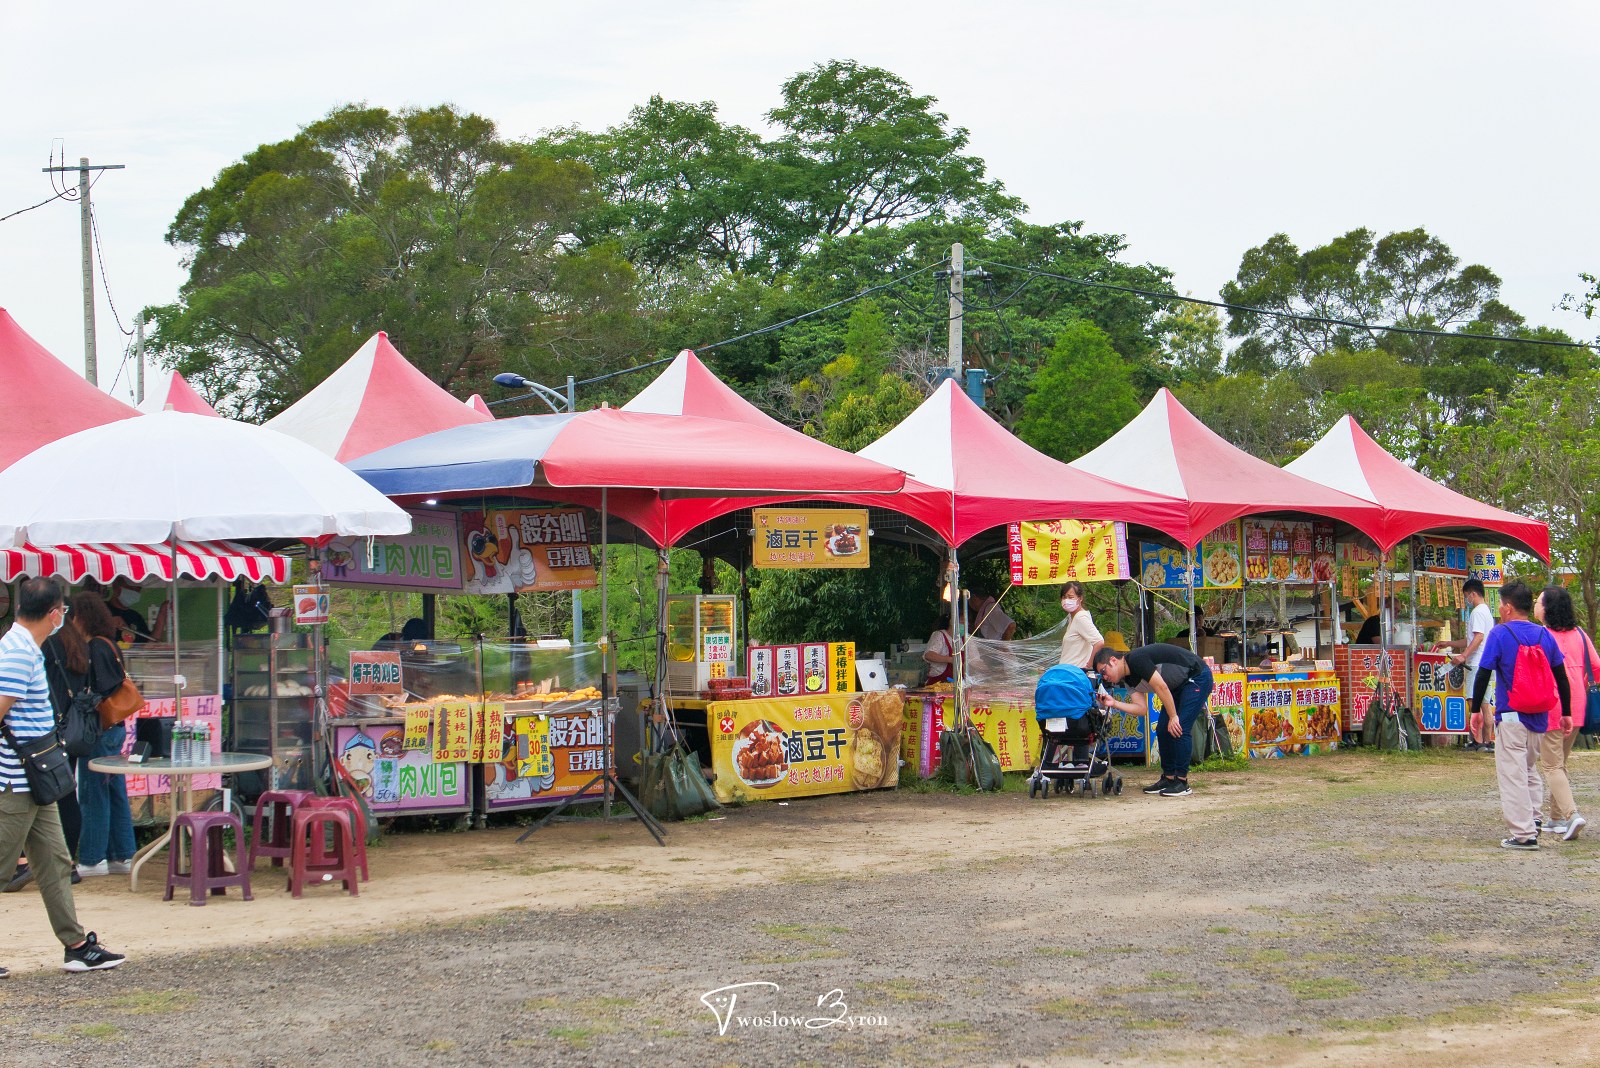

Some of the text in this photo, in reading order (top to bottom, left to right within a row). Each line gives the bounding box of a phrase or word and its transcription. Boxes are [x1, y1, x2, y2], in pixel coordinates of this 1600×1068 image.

[766, 529, 818, 549] 滷豆干
[384, 543, 454, 579] 肉刈包
[1424, 543, 1468, 571] 黑糖粉圓
[1473, 553, 1496, 566] 盆栽
[835, 644, 848, 693] 香椿拌麵
[1250, 690, 1292, 707] 無骨排骨酥
[1296, 687, 1338, 705] 無骨香酥雞
[414, 709, 429, 718] 100
[849, 704, 861, 724] 素
[1422, 697, 1466, 730] 粉圓
[414, 724, 428, 734] 150
[454, 708, 468, 745] 花枝丸
[489, 709, 502, 744] 熱狗
[453, 748, 467, 759] 30
[530, 740, 540, 755] 30
[781, 728, 847, 765] 滷豆干
[997, 720, 1012, 767] 金針菇
[436, 749, 450, 760] 30
[472, 749, 485, 760] 50
[488, 749, 500, 759] 30
[400, 763, 459, 799] 肉刈包
